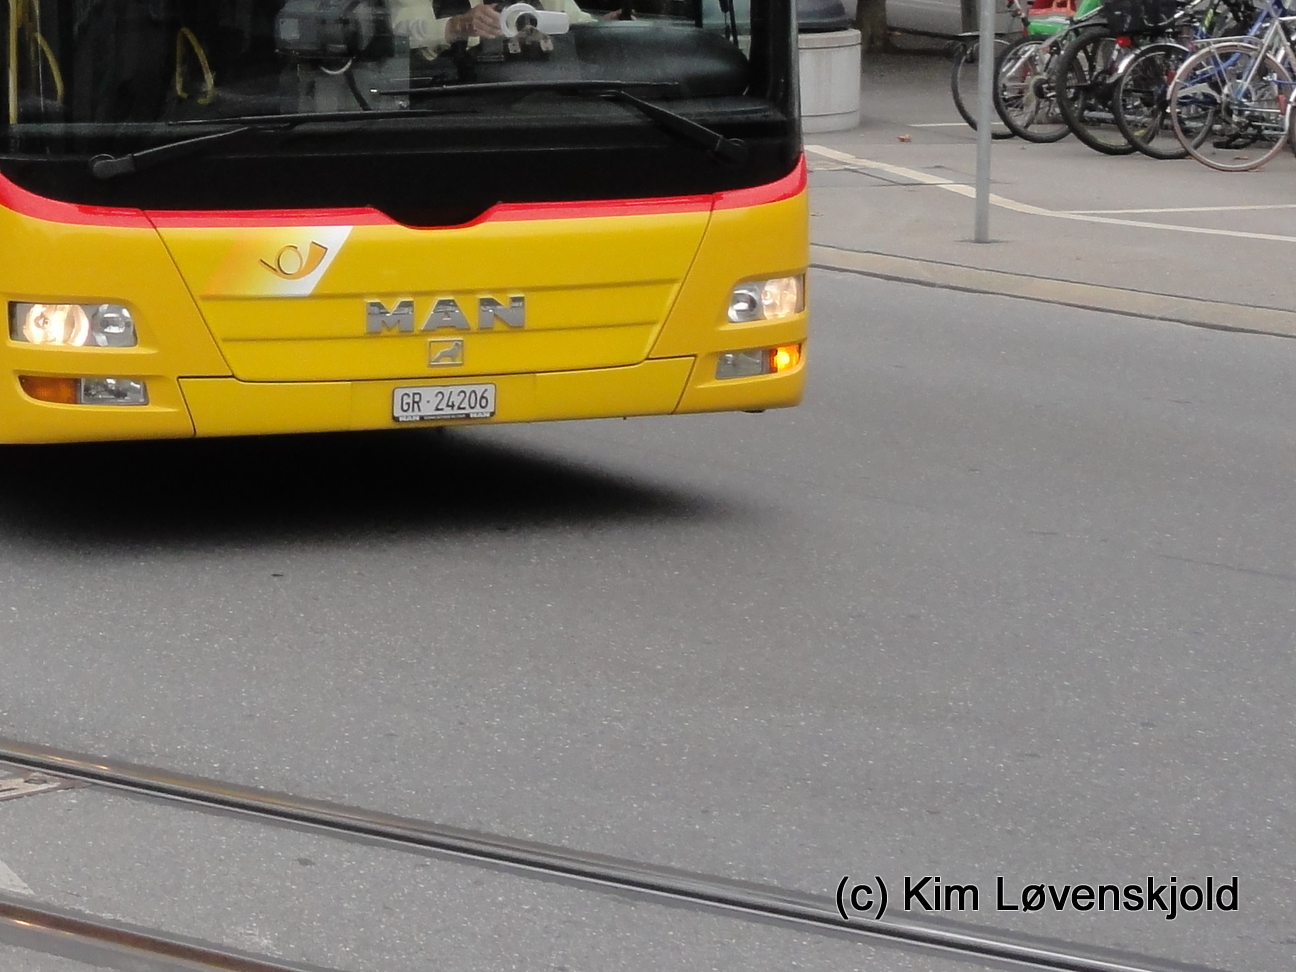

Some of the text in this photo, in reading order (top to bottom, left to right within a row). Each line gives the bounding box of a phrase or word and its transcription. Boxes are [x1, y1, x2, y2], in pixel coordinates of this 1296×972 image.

[365, 294, 525, 333] MAN
[400, 388, 489, 413] GR 24206
